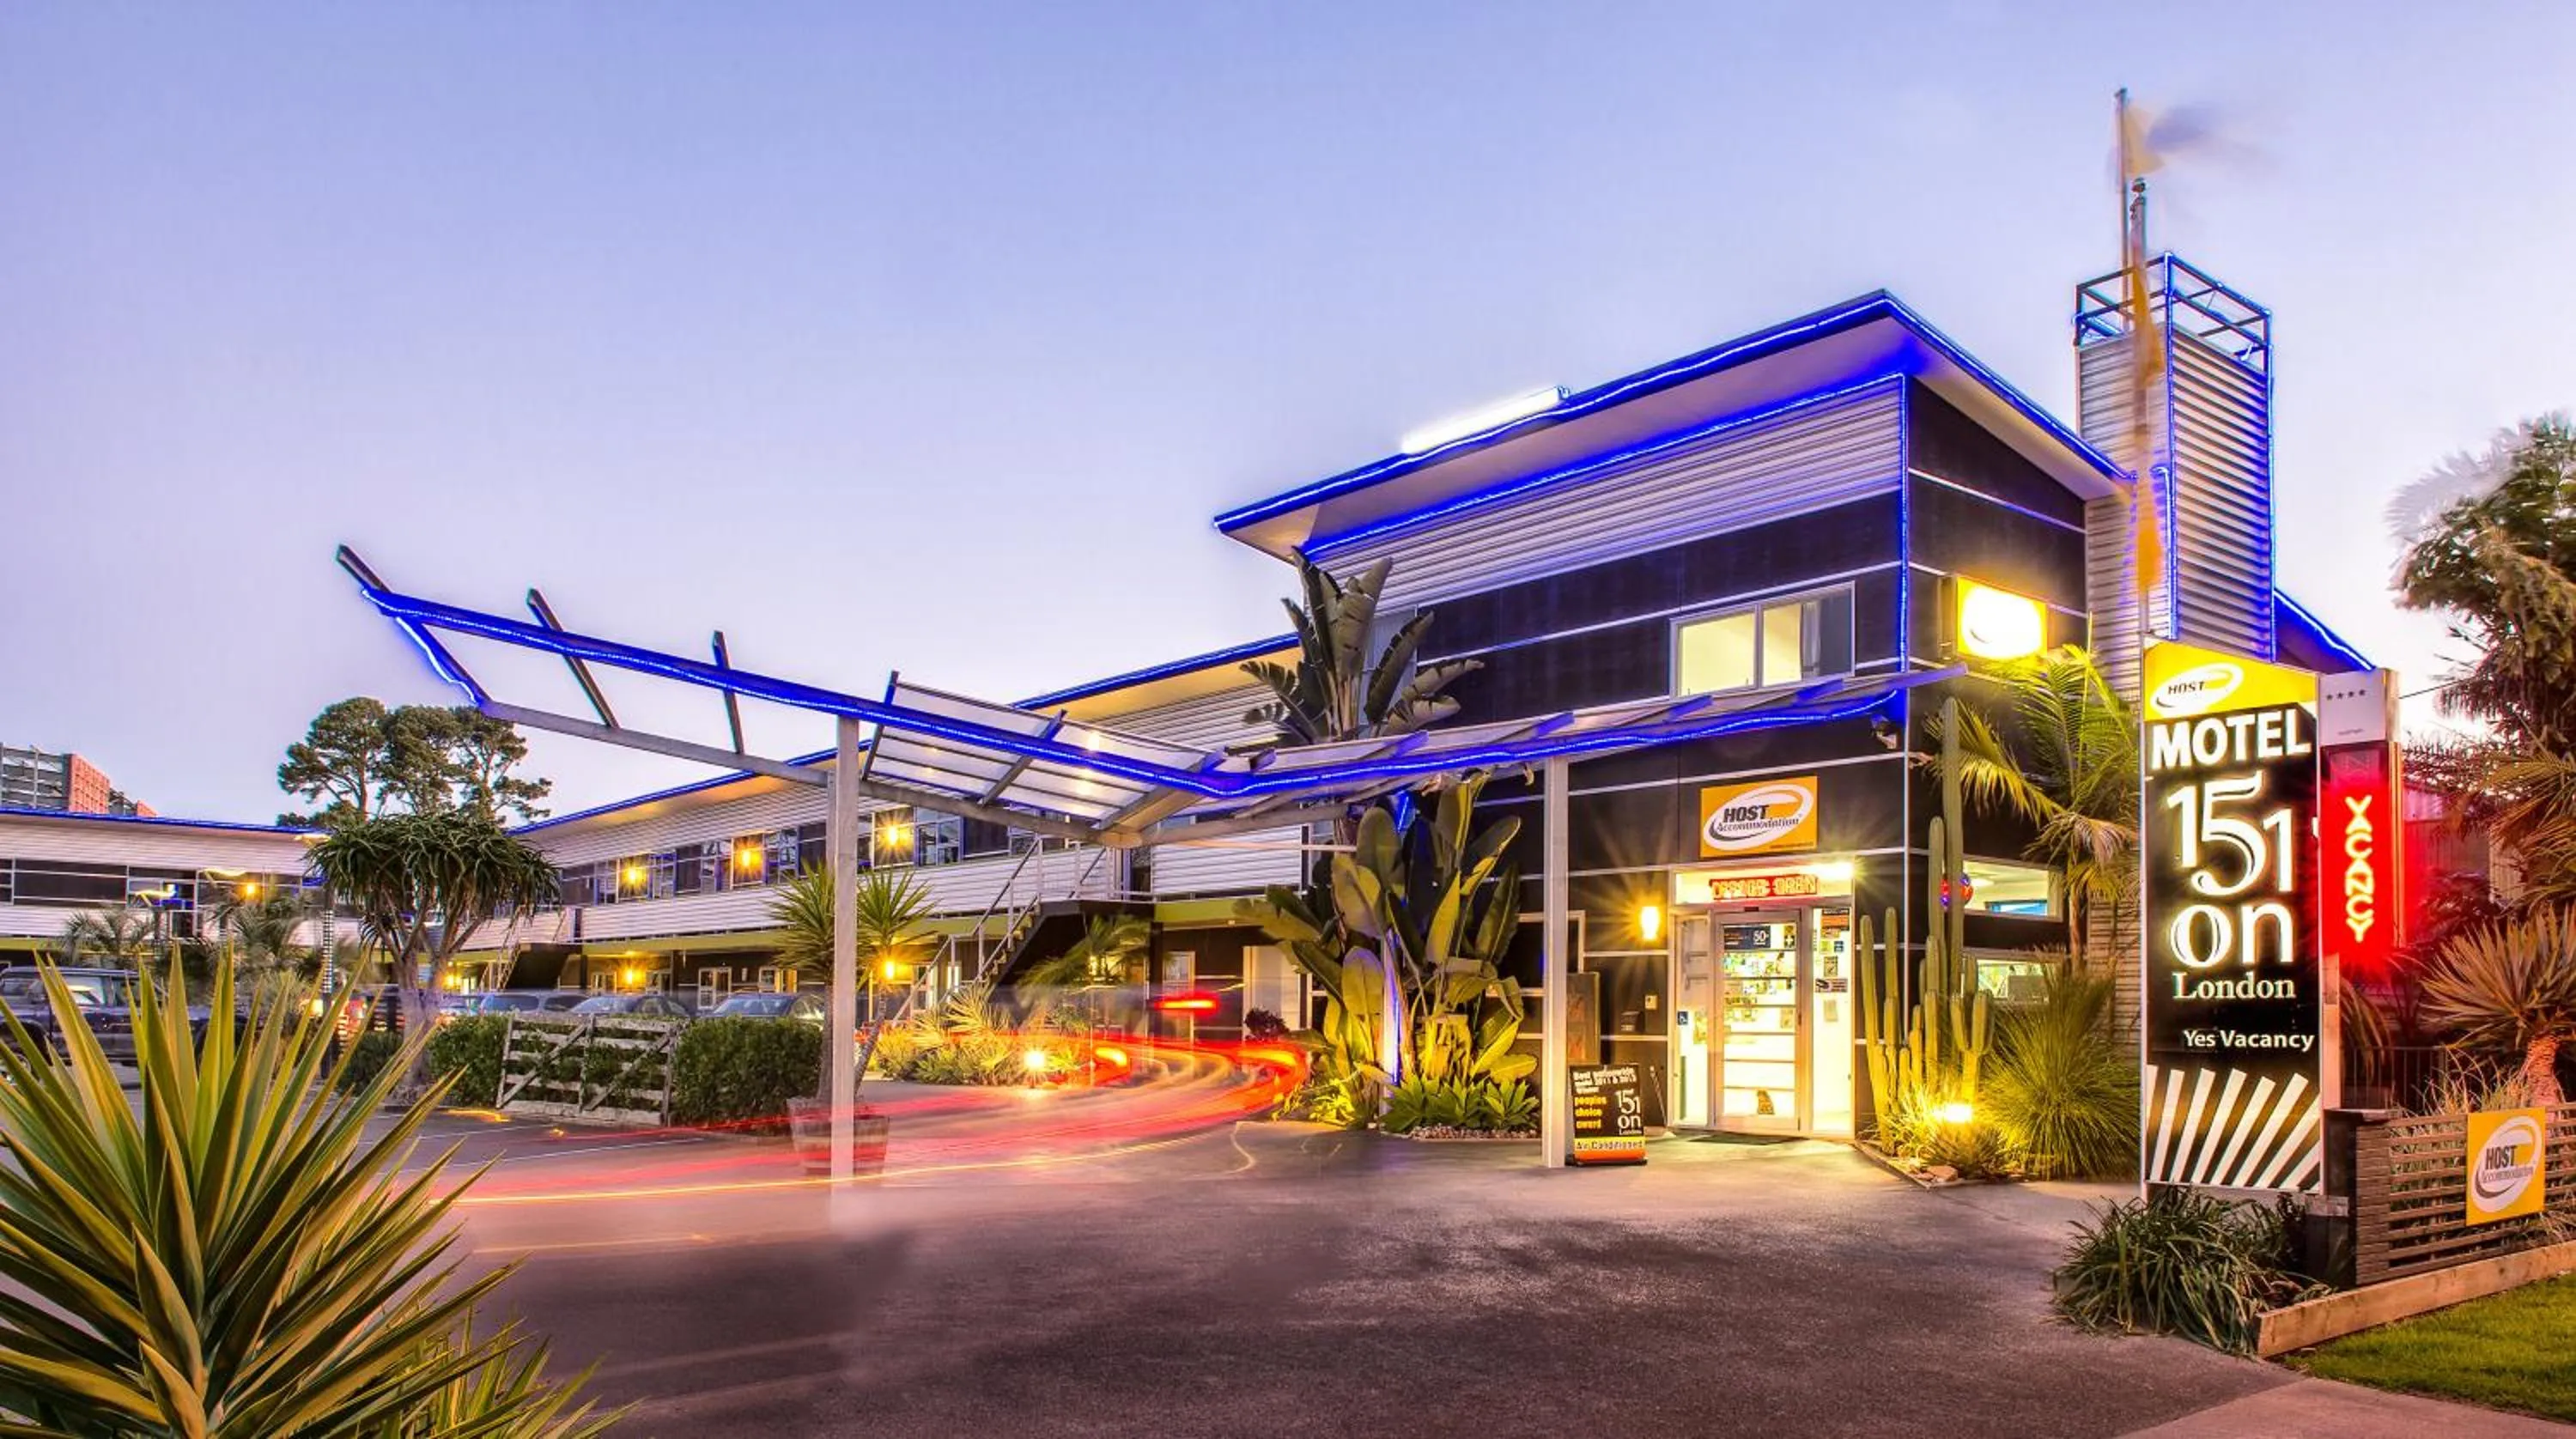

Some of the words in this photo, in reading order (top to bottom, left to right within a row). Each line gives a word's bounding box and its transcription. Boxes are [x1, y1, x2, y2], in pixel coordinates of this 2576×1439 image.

[2166, 680, 2205, 695] HOST
[2151, 708, 2312, 770] MOTEL
[1717, 817, 1800, 832] Accommodation
[1722, 805, 1770, 823] HOST
[2166, 770, 2293, 896] 151
[2344, 794, 2375, 943] VACANCY
[2170, 902, 2294, 968] on
[2172, 971, 2297, 999] London
[2183, 1029, 2215, 1047] Yes
[2221, 1030, 2315, 1052] Vacancy
[1615, 1089, 1641, 1114] 151
[1617, 1114, 1642, 1129] on
[2485, 1145, 2518, 1170] HOST
